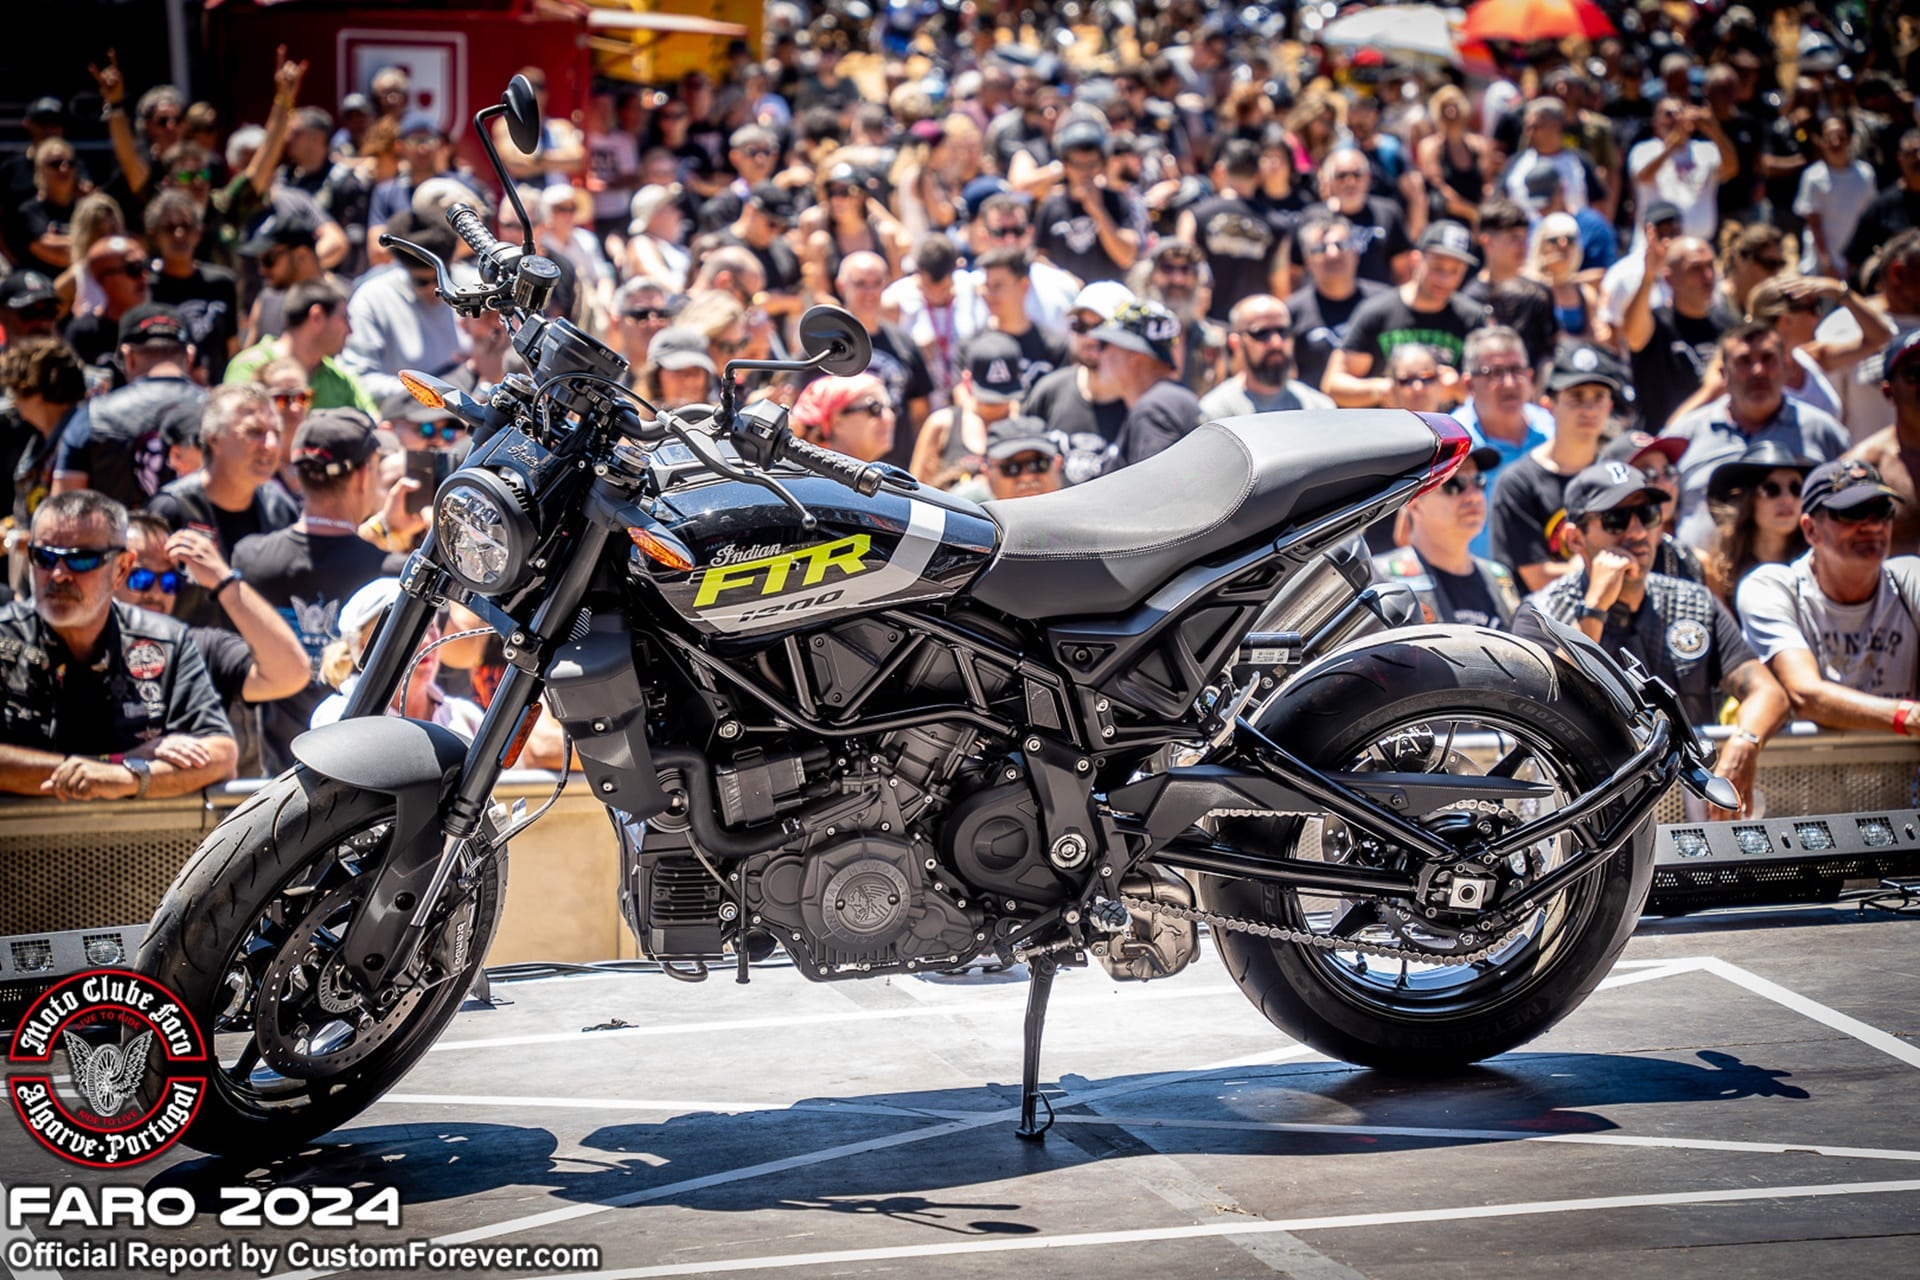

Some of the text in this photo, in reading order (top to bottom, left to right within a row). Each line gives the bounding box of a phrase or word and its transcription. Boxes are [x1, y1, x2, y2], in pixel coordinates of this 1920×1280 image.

[692, 533, 871, 608] FTR
[710, 543, 783, 567] Indian
[738, 589, 845, 623] 1200
[454, 921, 467, 965] brembo
